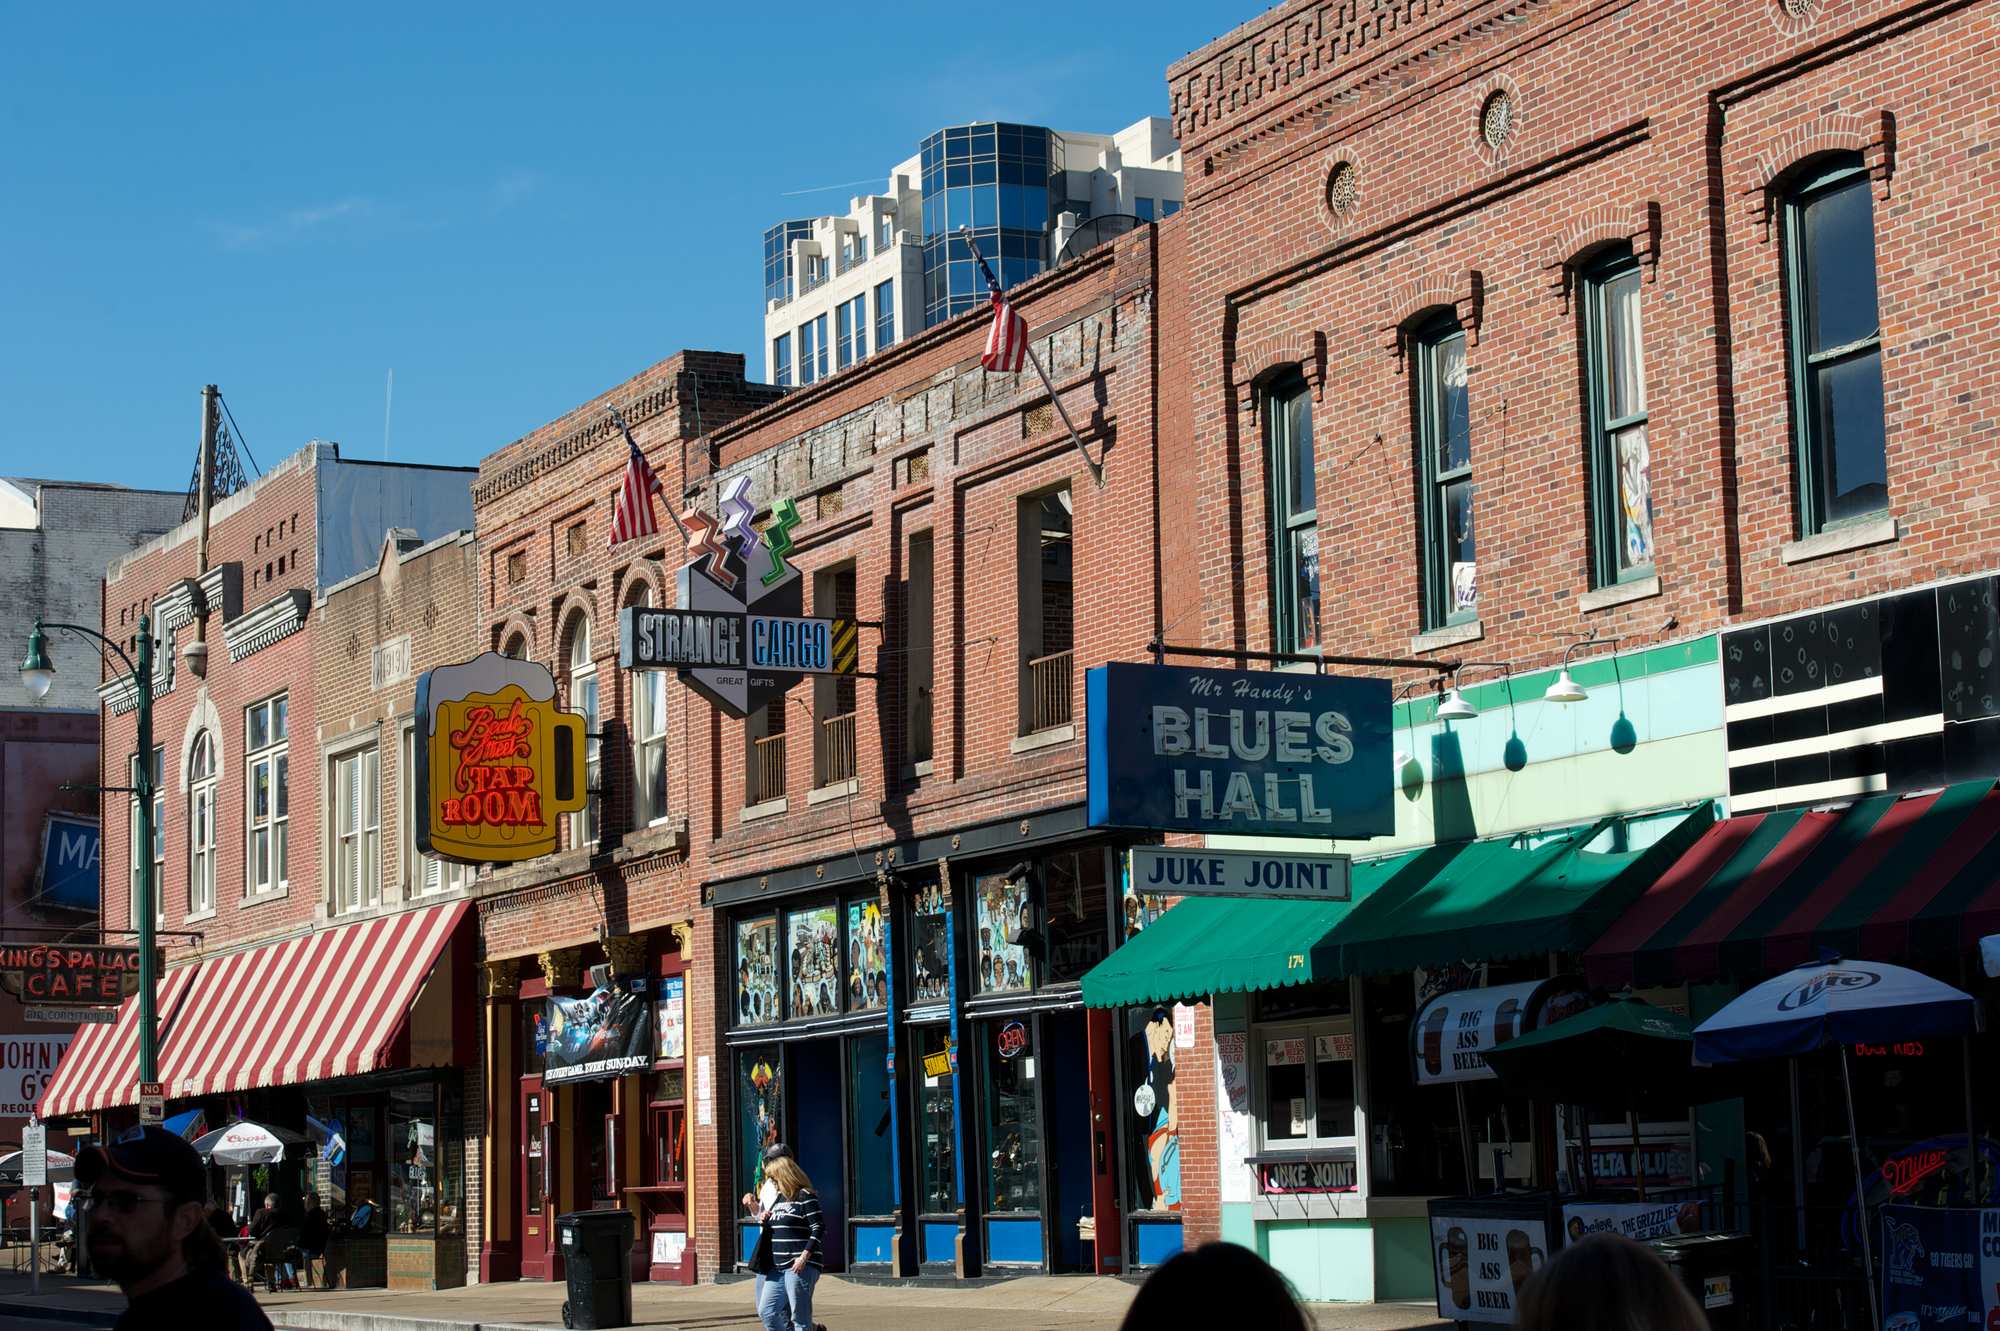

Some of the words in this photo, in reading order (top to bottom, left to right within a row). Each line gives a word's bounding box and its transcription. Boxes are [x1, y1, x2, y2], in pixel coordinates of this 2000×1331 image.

[639, 613, 740, 666] STRANGE
[752, 618, 827, 668] CARGO
[716, 676, 744, 686] GREAT
[750, 678, 775, 688] GIFTS
[1189, 675, 1222, 698] Mr
[1231, 678, 1314, 704] Handy's
[451, 698, 532, 746] Beale
[1152, 706, 1354, 765] BLUES
[456, 736, 531, 791] Street
[469, 767, 533, 789] TAP
[1173, 768, 1333, 825] HALL
[442, 790, 542, 826] ROOM
[1148, 857, 1225, 886] JUKE
[1244, 861, 1333, 890] JOINT
[1288, 954, 1304, 969] 174
[27, 973, 119, 997] CAFE
[26, 1009, 43, 1019] AIR
[47, 1010, 114, 1021] CONDITIONED
[1458, 1010, 1482, 1029] BIG
[997, 1028, 1026, 1051] OPEN
[1178, 1024, 1182, 1036] 3
[1183, 1024, 1193, 1035] AM
[1217, 1034, 1228, 1045] BIG
[1231, 1033, 1246, 1044] ASS
[1220, 1044, 1243, 1054] BEERS
[1284, 1041, 1294, 1049] BIG
[1333, 1036, 1343, 1045] BIG
[1456, 1030, 1479, 1050] ASS
[1222, 1054, 1231, 1064] TO
[1233, 1053, 1243, 1063] GO
[1286, 1048, 1305, 1056] BEERS
[584, 1061, 606, 1073] EVERY
[606, 1055, 649, 1070] SUNDAY.
[144, 1084, 160, 1094] NO
[227, 1133, 268, 1143] Coors
[1270, 1164, 1307, 1189] JUKE
[1313, 1161, 1354, 1188] JOINT
[1882, 1150, 1947, 1190] Miller
[1583, 1218, 1613, 1235] believe
[1621, 1217, 1637, 1235] THE
[1637, 1203, 1679, 1228] GRIZZLIES
[1477, 1233, 1498, 1251] BIG
[1930, 1252, 1939, 1267] GO
[1940, 1252, 1963, 1268] TIGERS
[1963, 1253, 1975, 1269] GO!
[1479, 1261, 1501, 1280] ASS
[1476, 1290, 1511, 1310] BEER
[1920, 1304, 1933, 1318] IT'S
[1933, 1304, 1968, 1323] Miller
[1968, 1310, 1981, 1323] TIME
